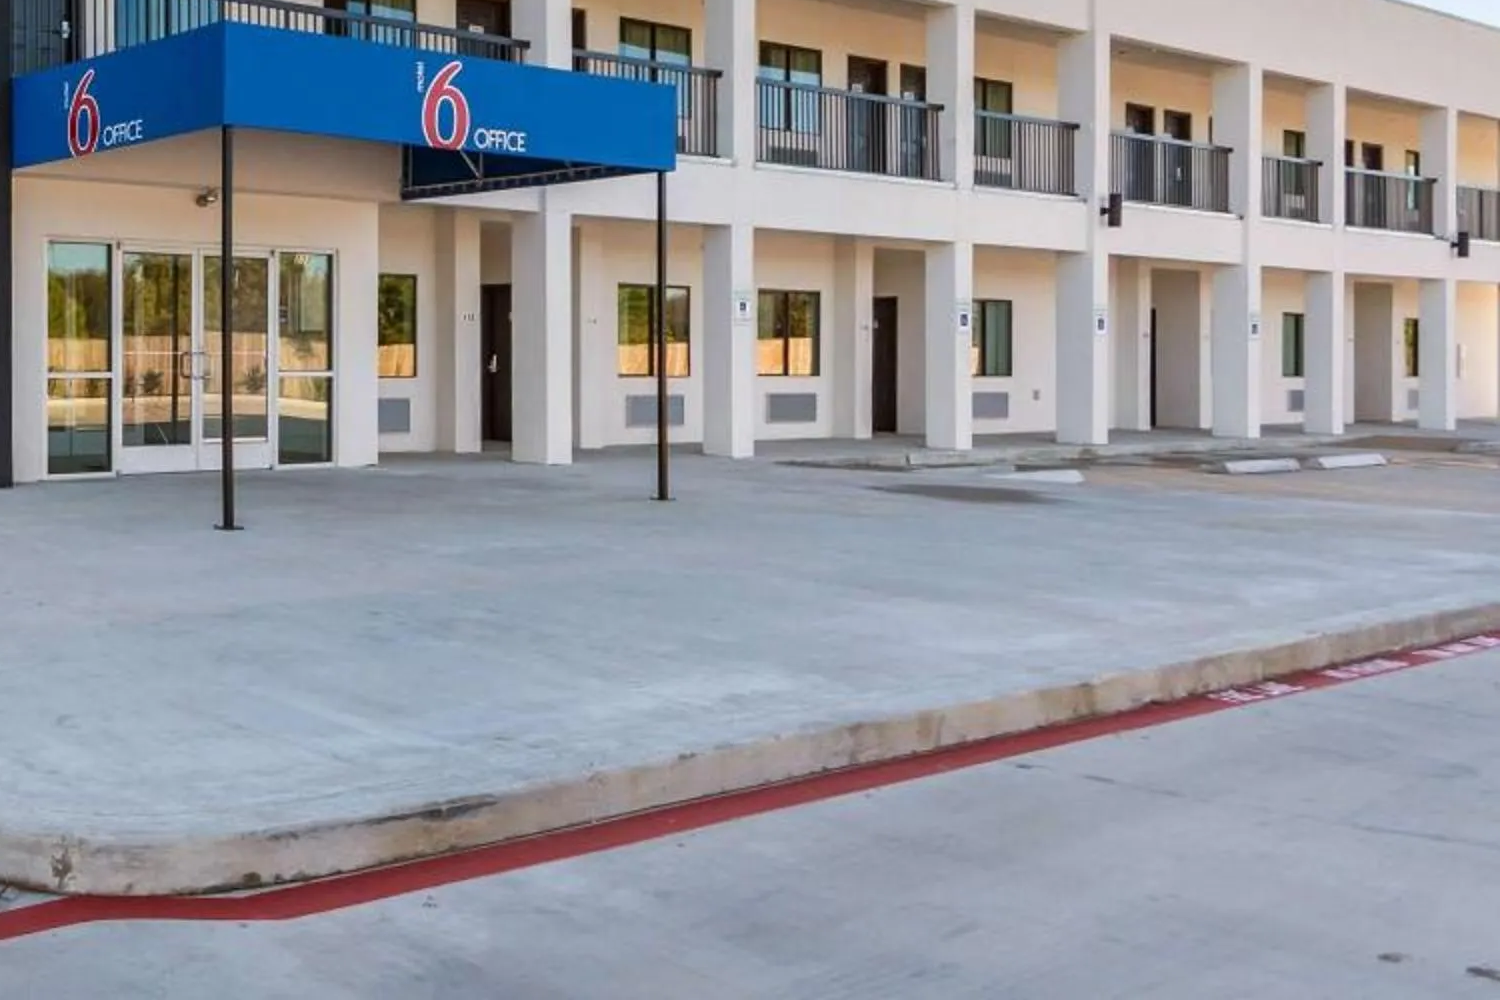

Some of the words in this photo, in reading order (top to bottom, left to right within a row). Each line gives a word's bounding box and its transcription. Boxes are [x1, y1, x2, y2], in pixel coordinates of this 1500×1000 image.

[67, 68, 101, 157] 6
[102, 119, 143, 147] OFFICE
[421, 60, 471, 151] 6
[473, 127, 527, 153] OFFICE
